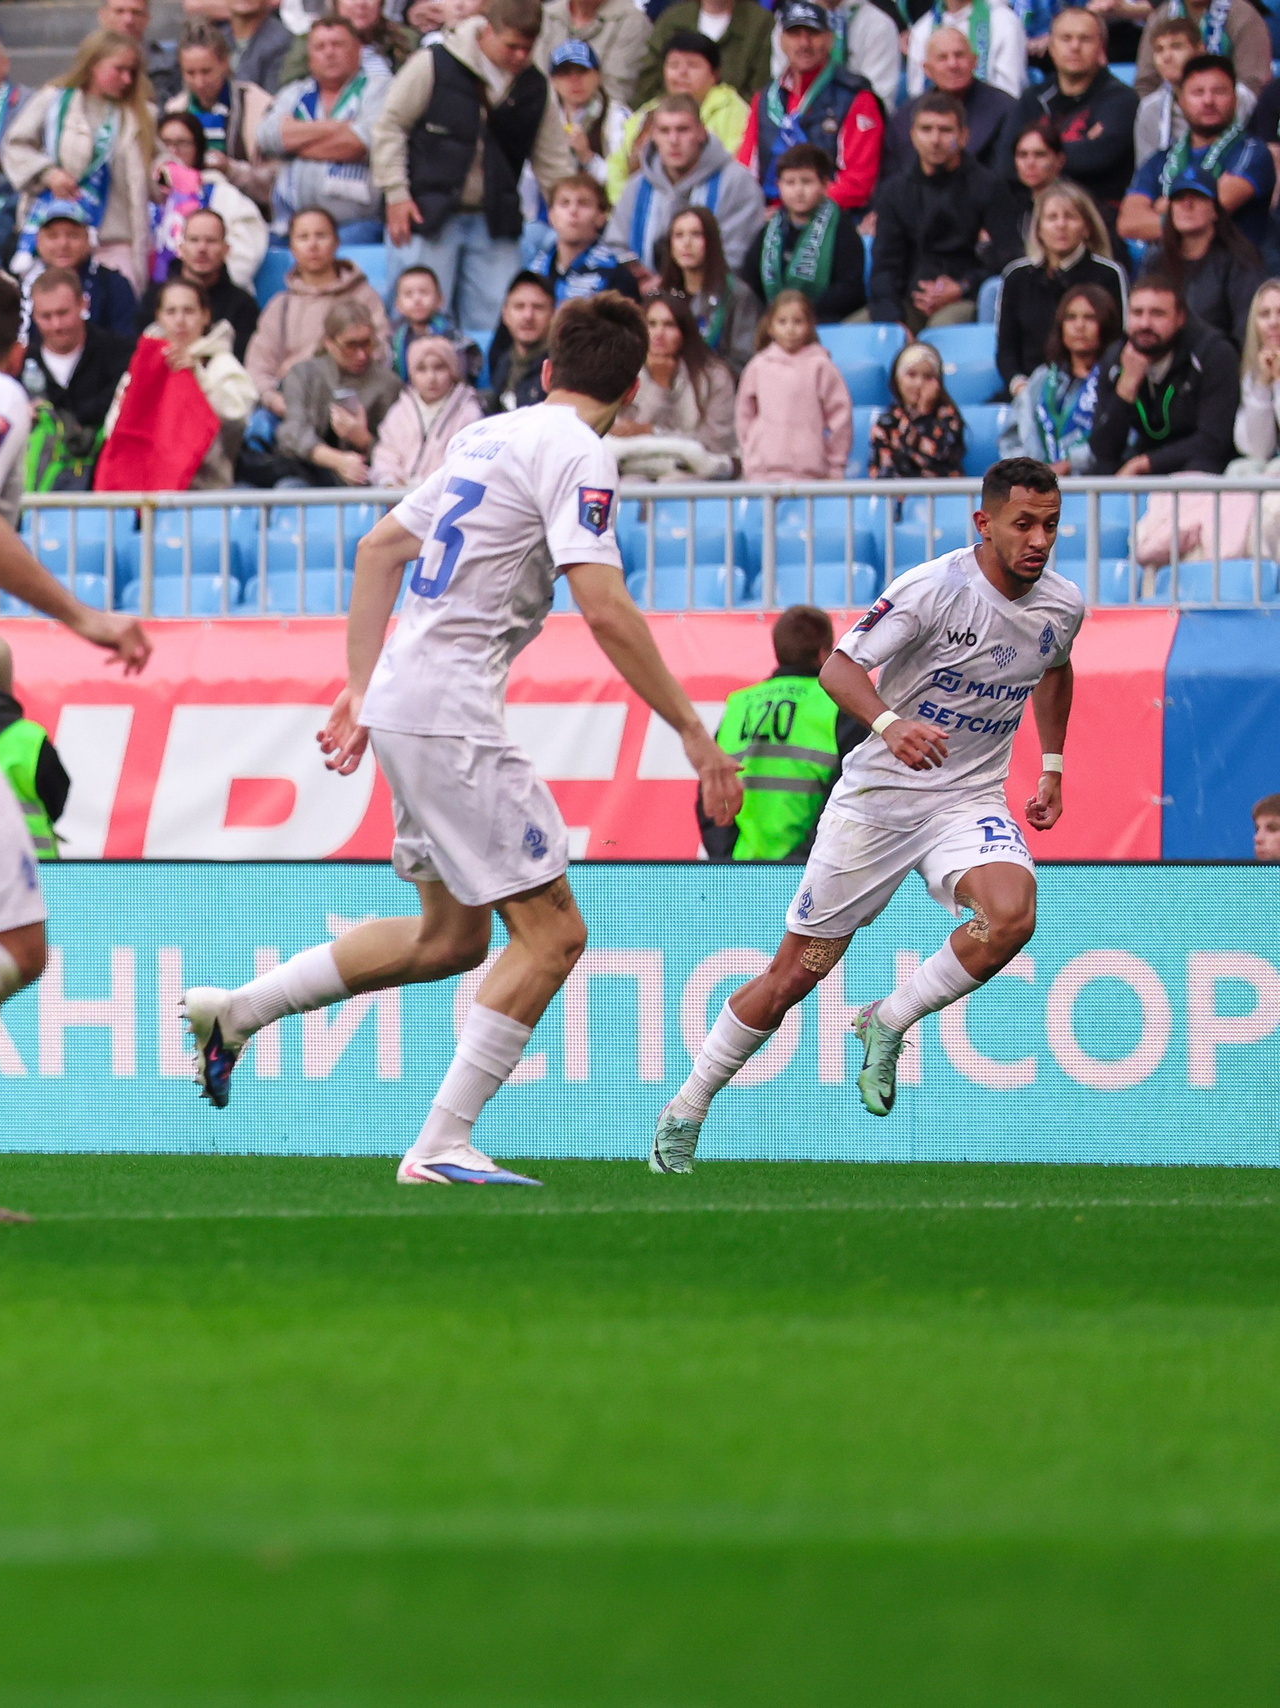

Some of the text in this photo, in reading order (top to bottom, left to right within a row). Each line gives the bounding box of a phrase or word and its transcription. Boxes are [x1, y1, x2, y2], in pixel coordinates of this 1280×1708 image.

[410, 476, 488, 600] 3
[946, 627, 977, 647] wb
[979, 844, 1034, 866] БЕТСИ
